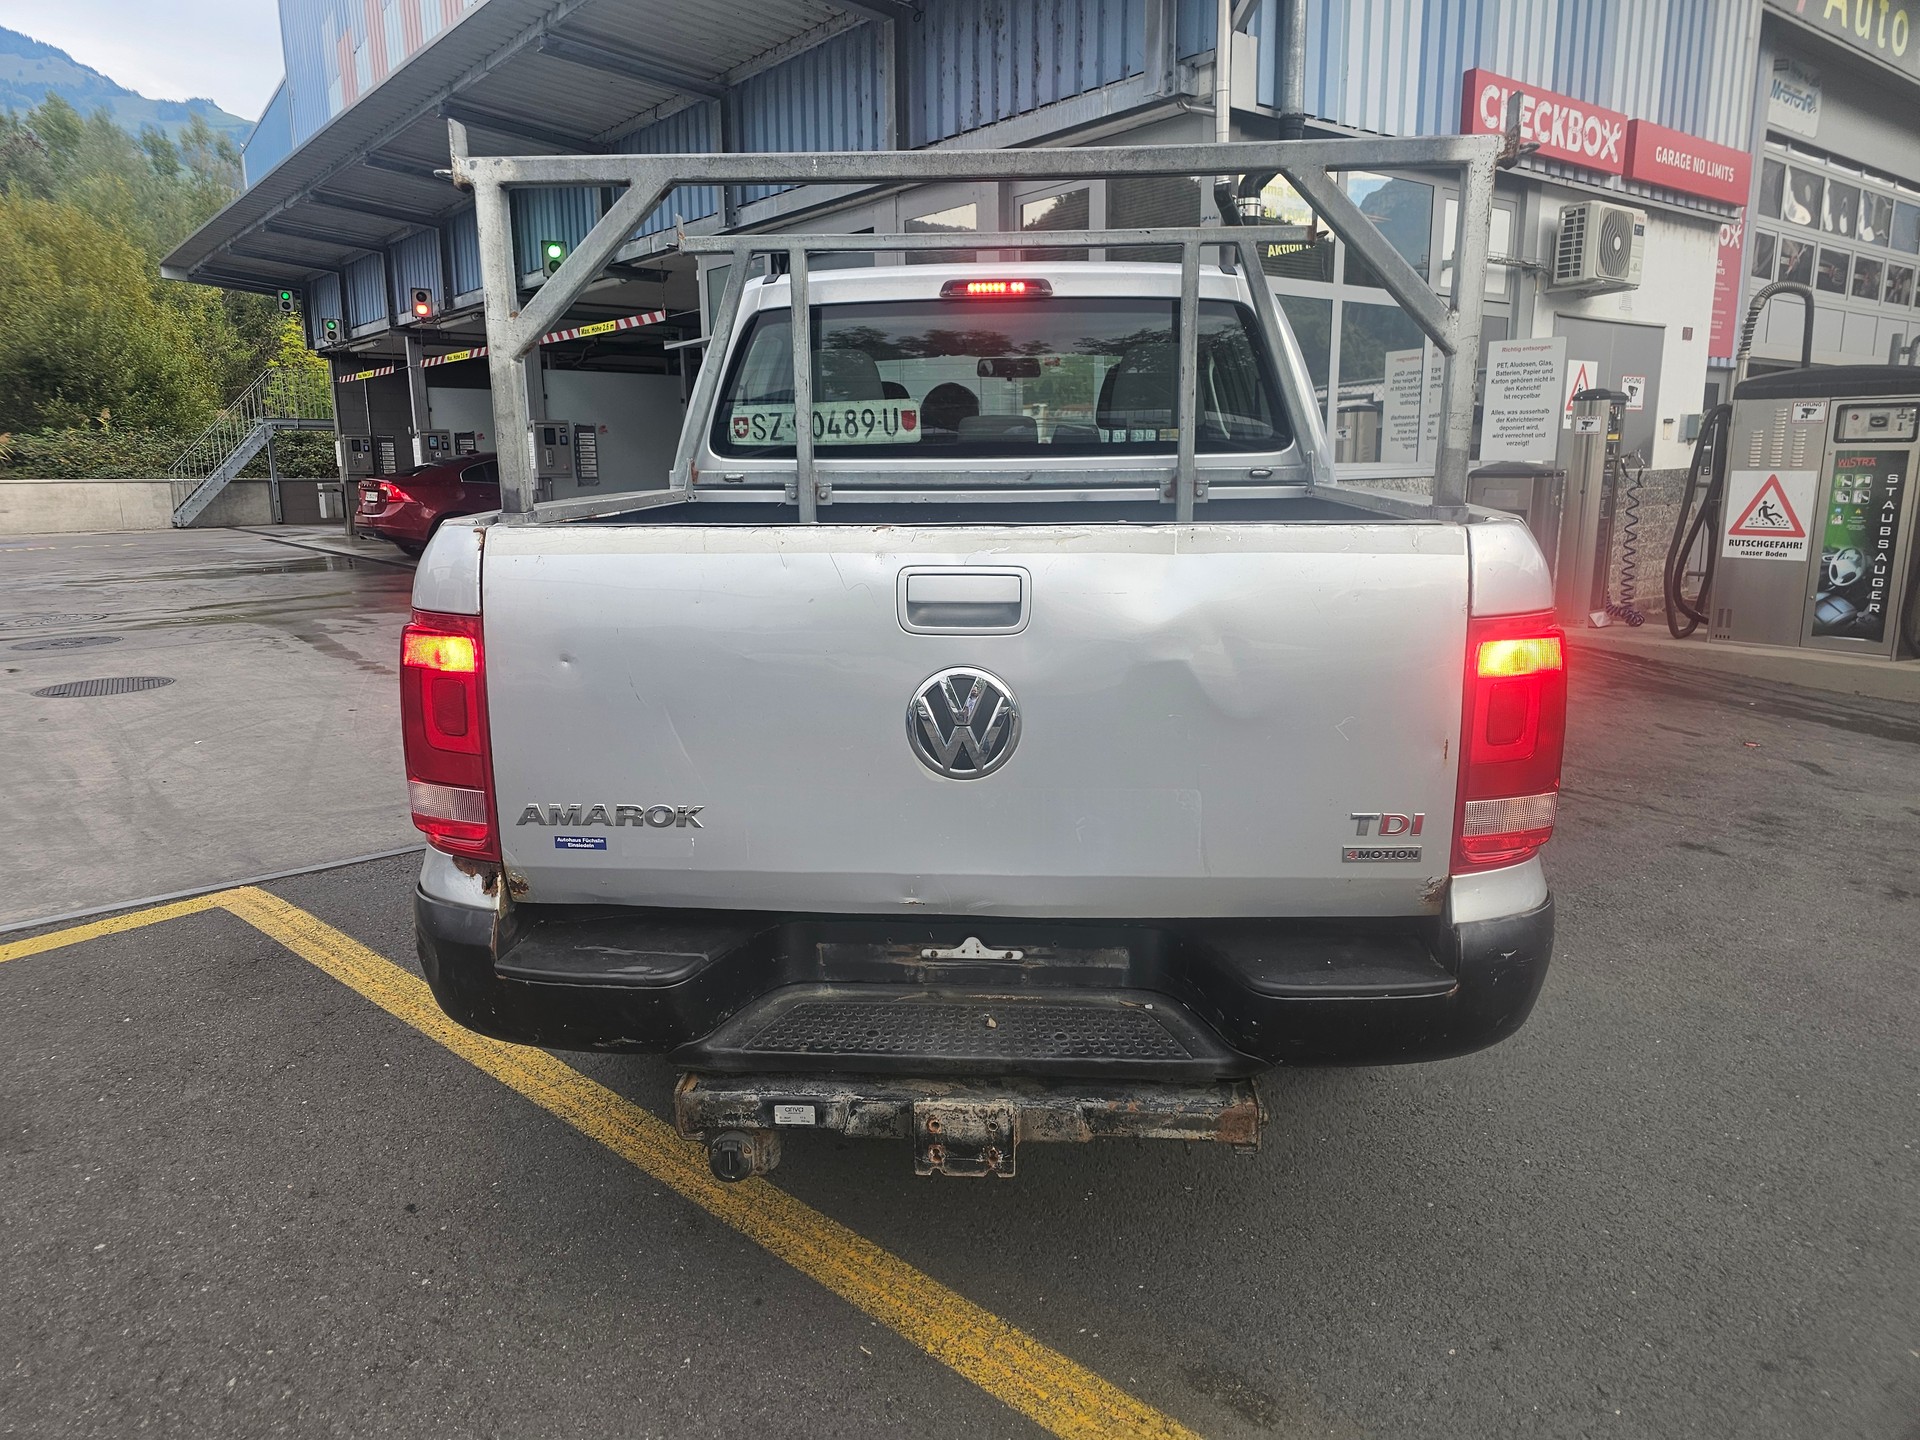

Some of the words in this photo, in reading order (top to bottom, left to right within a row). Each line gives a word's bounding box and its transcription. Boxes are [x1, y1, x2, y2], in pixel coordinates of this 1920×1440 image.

[1655, 146, 1692, 171] GARAGE
[1693, 153, 1706, 174] NO
[1707, 160, 1735, 183] LIMITS
[1522, 344, 1553, 352] entsorgen:
[1509, 376, 1533, 385] gehören
[1533, 375, 1549, 383] nicht
[1515, 384, 1542, 392] Kehricht!
[1511, 392, 1541, 401] recycelbar
[1504, 431, 1534, 439] verrechnet
[1838, 457, 1877, 468] WISTRA
[1729, 539, 1803, 550] RUTSCHGEFAHR!
[1869, 474, 1899, 613] STAUBSAUGER
[516, 803, 705, 828] AMAROK
[1350, 812, 1426, 837] TDI
[1346, 850, 1419, 861] 4MOTION
